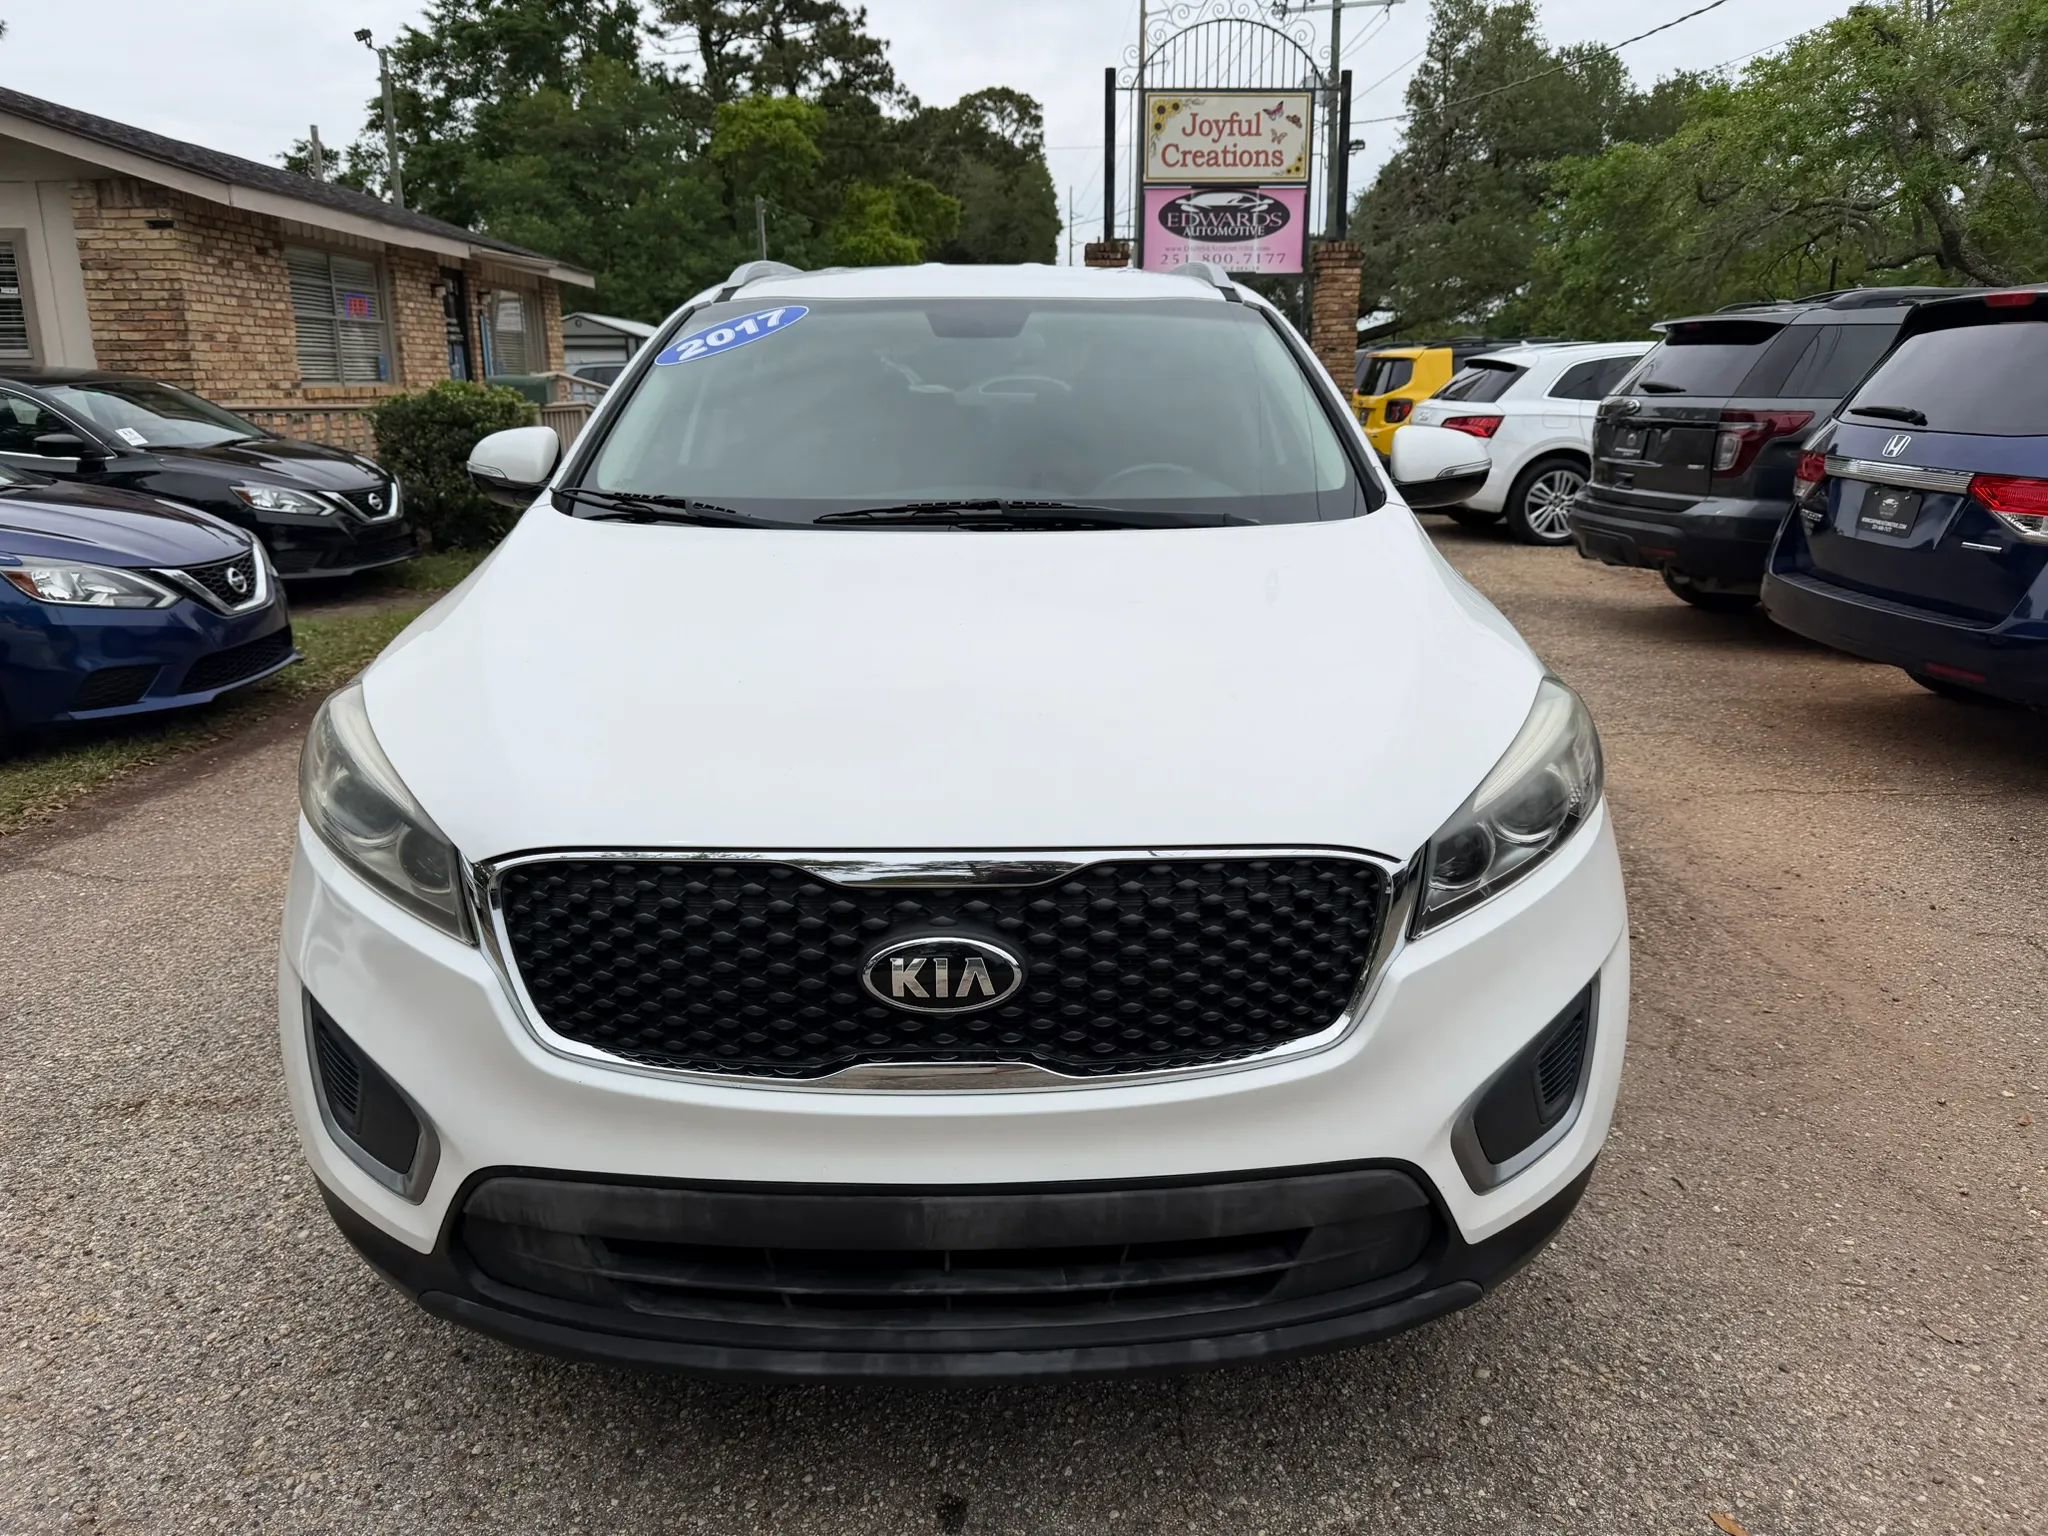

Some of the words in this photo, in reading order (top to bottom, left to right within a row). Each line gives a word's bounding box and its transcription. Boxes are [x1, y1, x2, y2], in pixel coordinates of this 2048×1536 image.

[1182, 111, 1262, 143] Joyful
[1161, 143, 1284, 168] Creations
[1167, 212, 1283, 227] EDWARDS
[1183, 225, 1265, 236] AUTOMOTIVE
[676, 308, 786, 361] 2017
[890, 957, 996, 998] KIA
